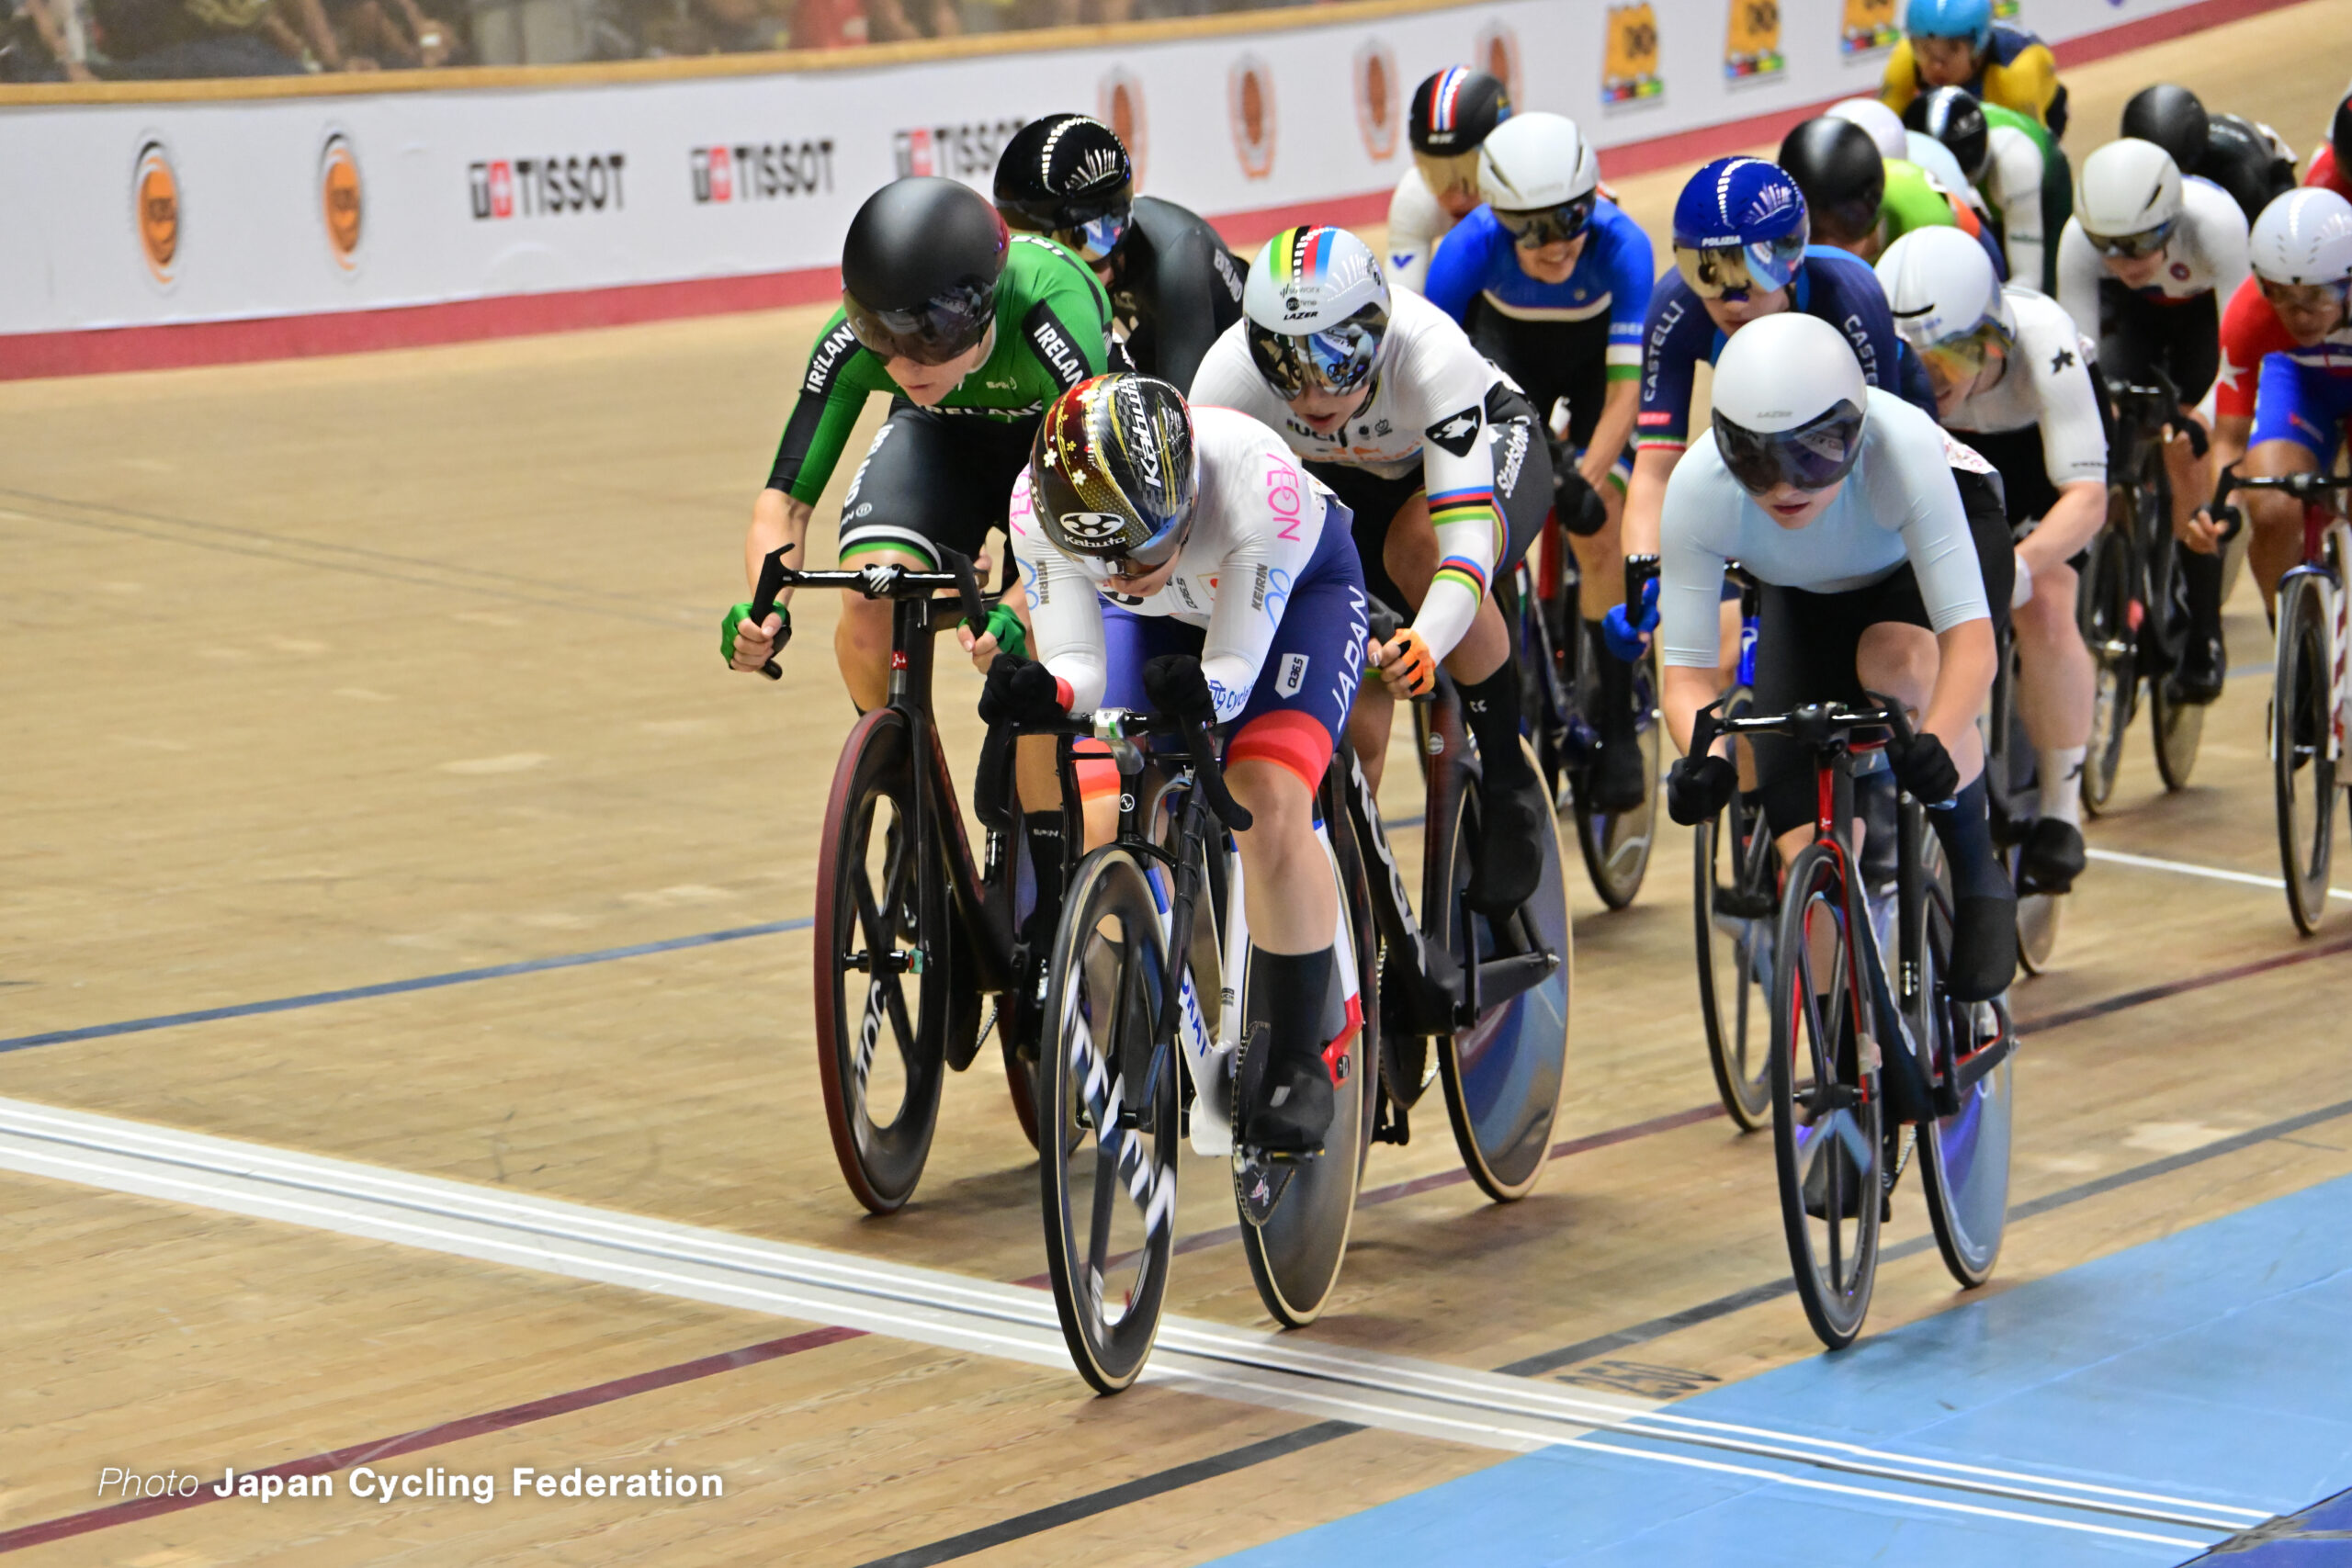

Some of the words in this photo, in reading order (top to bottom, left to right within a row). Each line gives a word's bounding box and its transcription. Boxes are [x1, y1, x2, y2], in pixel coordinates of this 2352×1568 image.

[516, 154, 626, 217] TISSOT
[734, 141, 833, 201] TISSOT
[1702, 235, 1742, 246] POLIZIA
[1283, 311, 1318, 321] LAZER
[806, 322, 856, 394] IRELAN
[1644, 299, 1685, 402] CASTELLI
[1844, 314, 1879, 388] CASTE
[1064, 534, 1126, 547] Kabuto
[1250, 562, 1269, 613] KEIRIN
[1332, 584, 1369, 734] JAPAN
